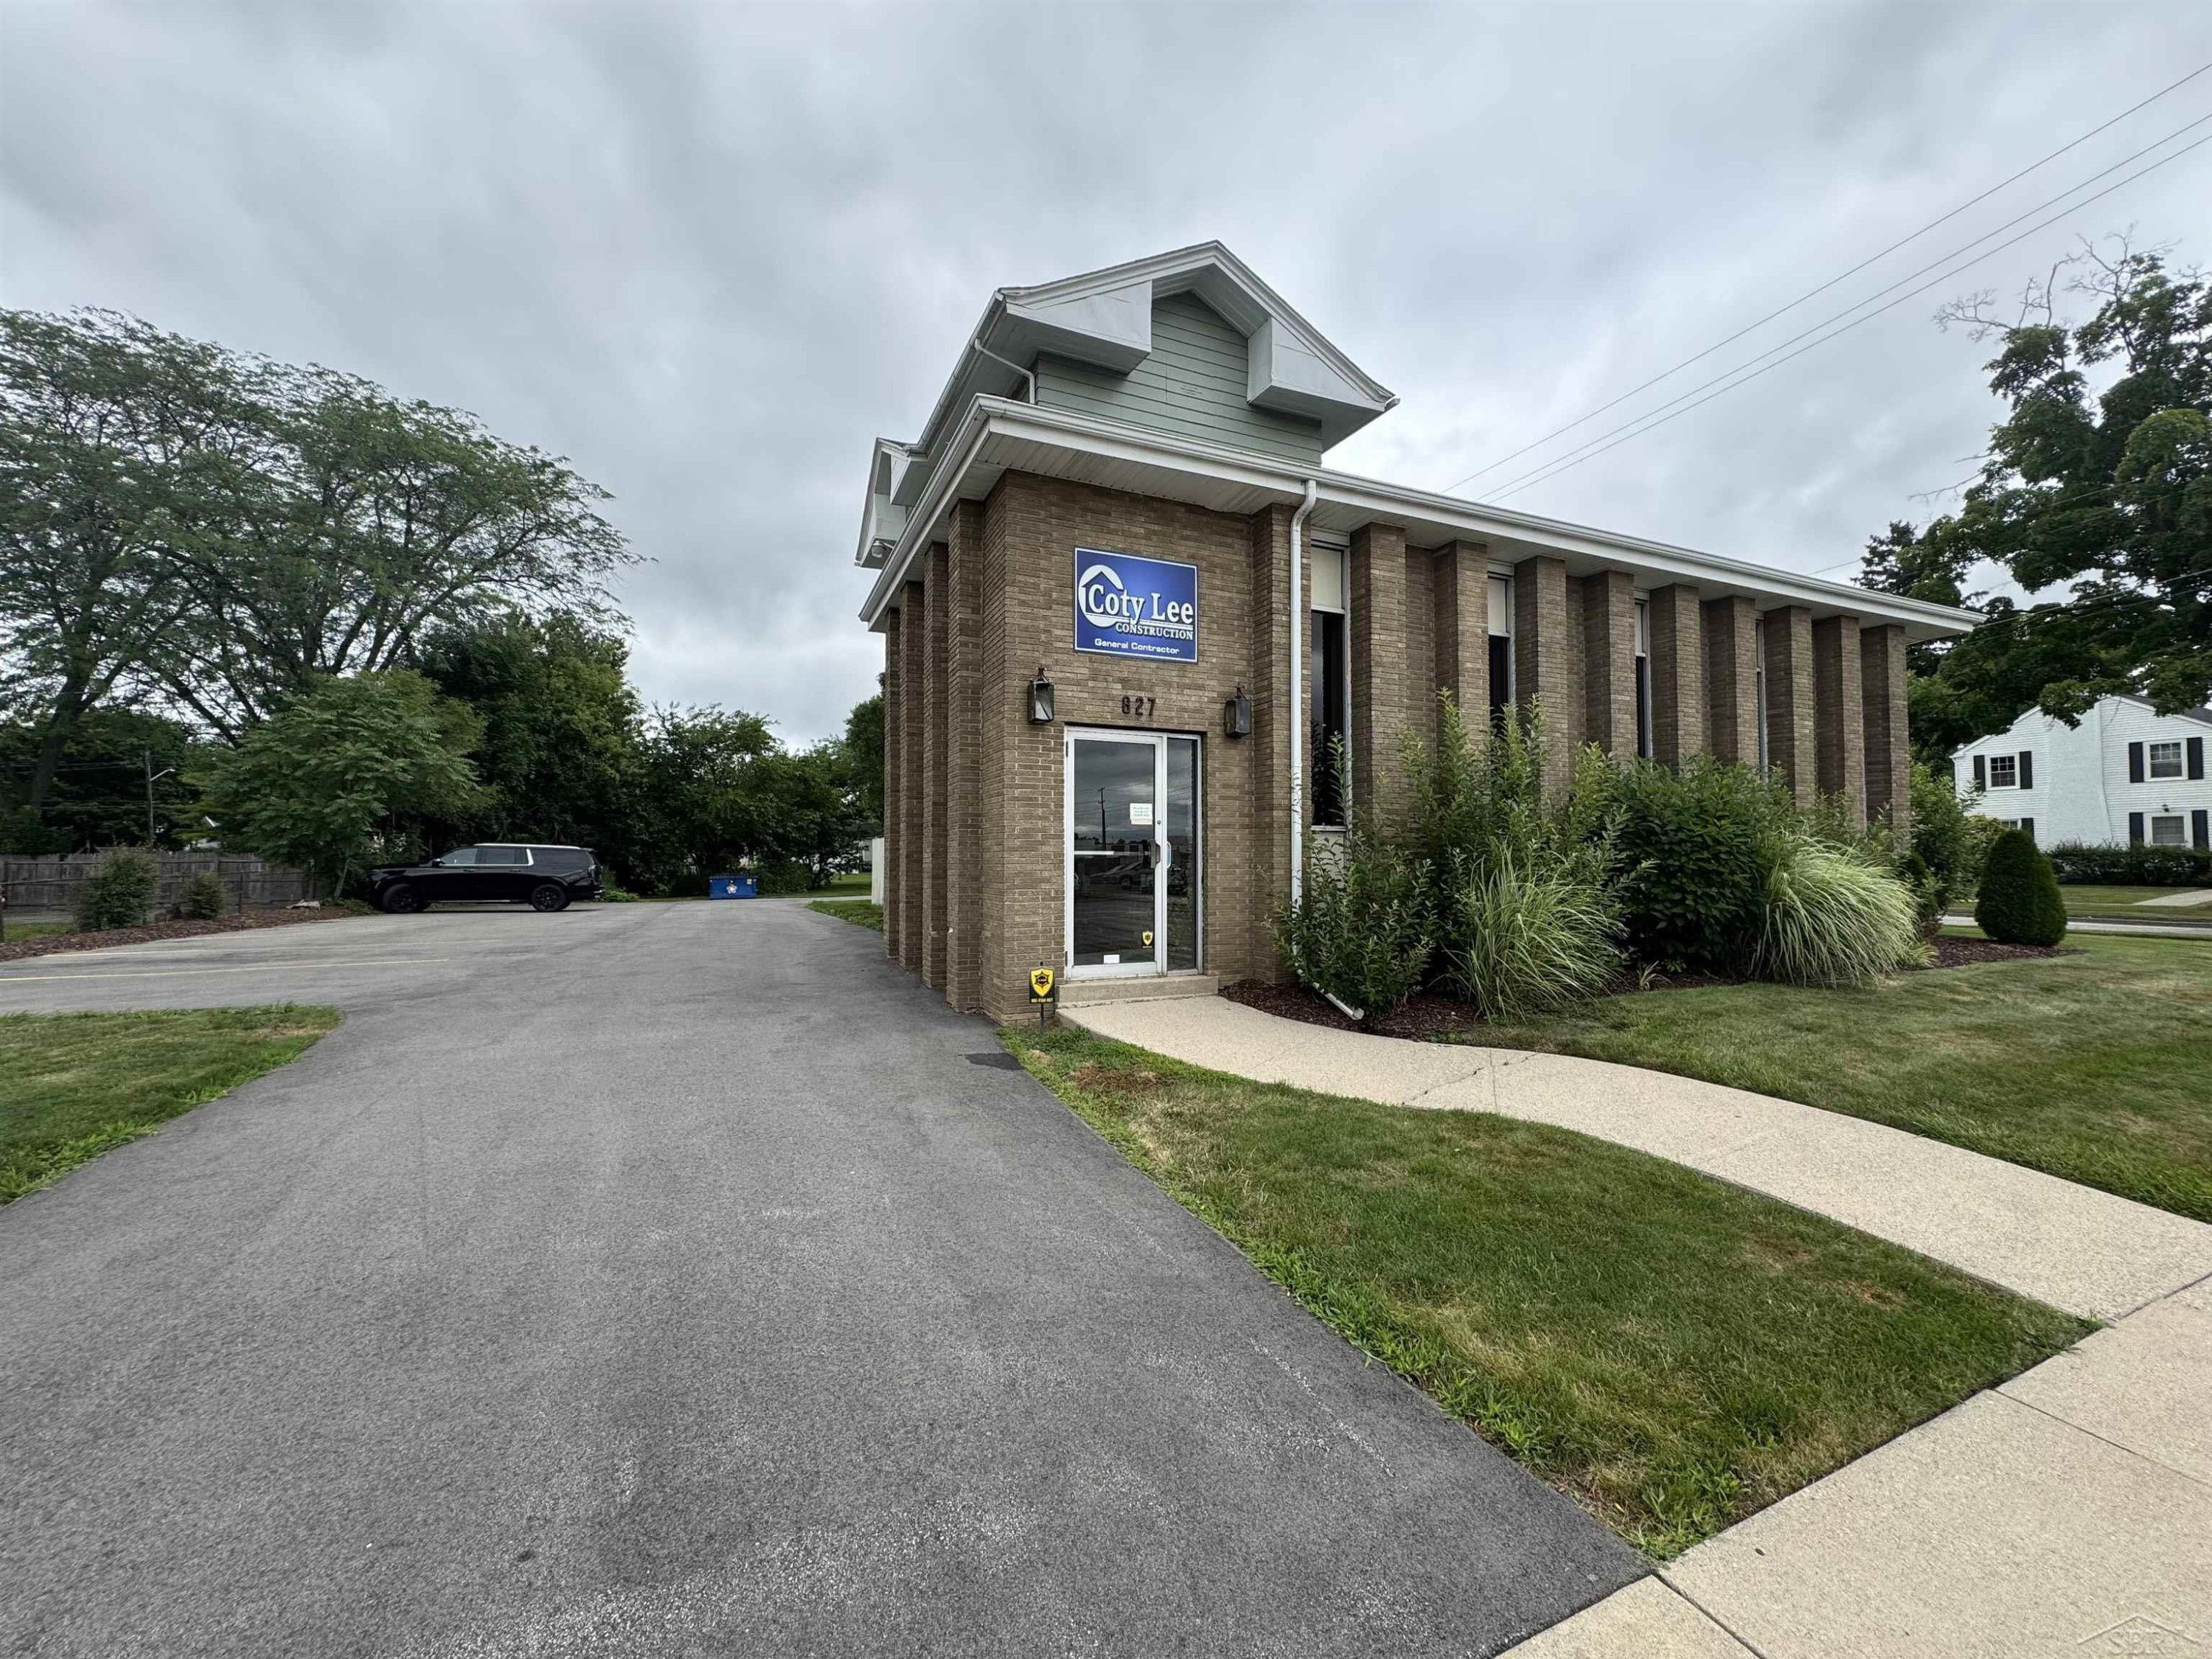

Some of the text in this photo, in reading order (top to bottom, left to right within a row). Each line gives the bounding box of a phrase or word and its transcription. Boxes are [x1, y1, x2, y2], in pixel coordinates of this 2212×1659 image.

[1088, 583, 1194, 625] Coty Lee
[1116, 622, 1194, 641] CONSTRUCTION
[1094, 638, 1180, 655] General Contractor
